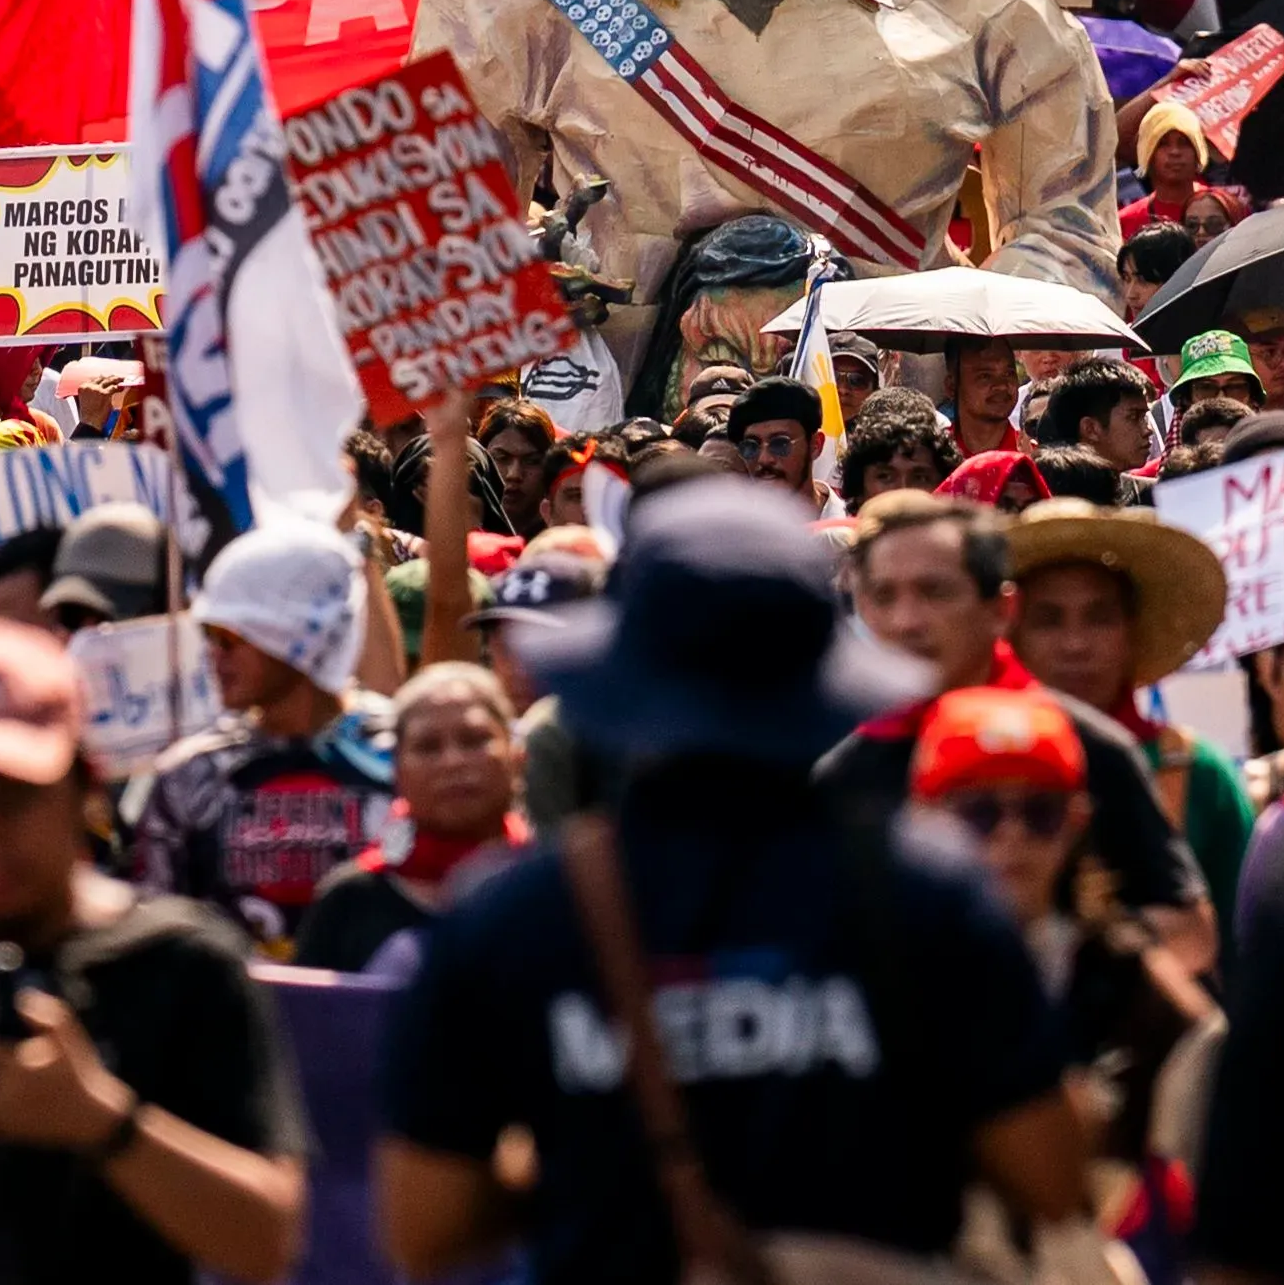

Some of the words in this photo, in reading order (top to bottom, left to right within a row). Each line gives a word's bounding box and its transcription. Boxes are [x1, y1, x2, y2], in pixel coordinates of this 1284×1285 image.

[284, 79, 417, 166] ONDO
[420, 82, 471, 118] SA
[4, 198, 109, 228] MARCOS
[427, 173, 505, 233] SA
[24, 230, 57, 257] NG
[13, 258, 161, 289] PANAGUTIN!
[546, 972, 882, 1094] MEDIA
